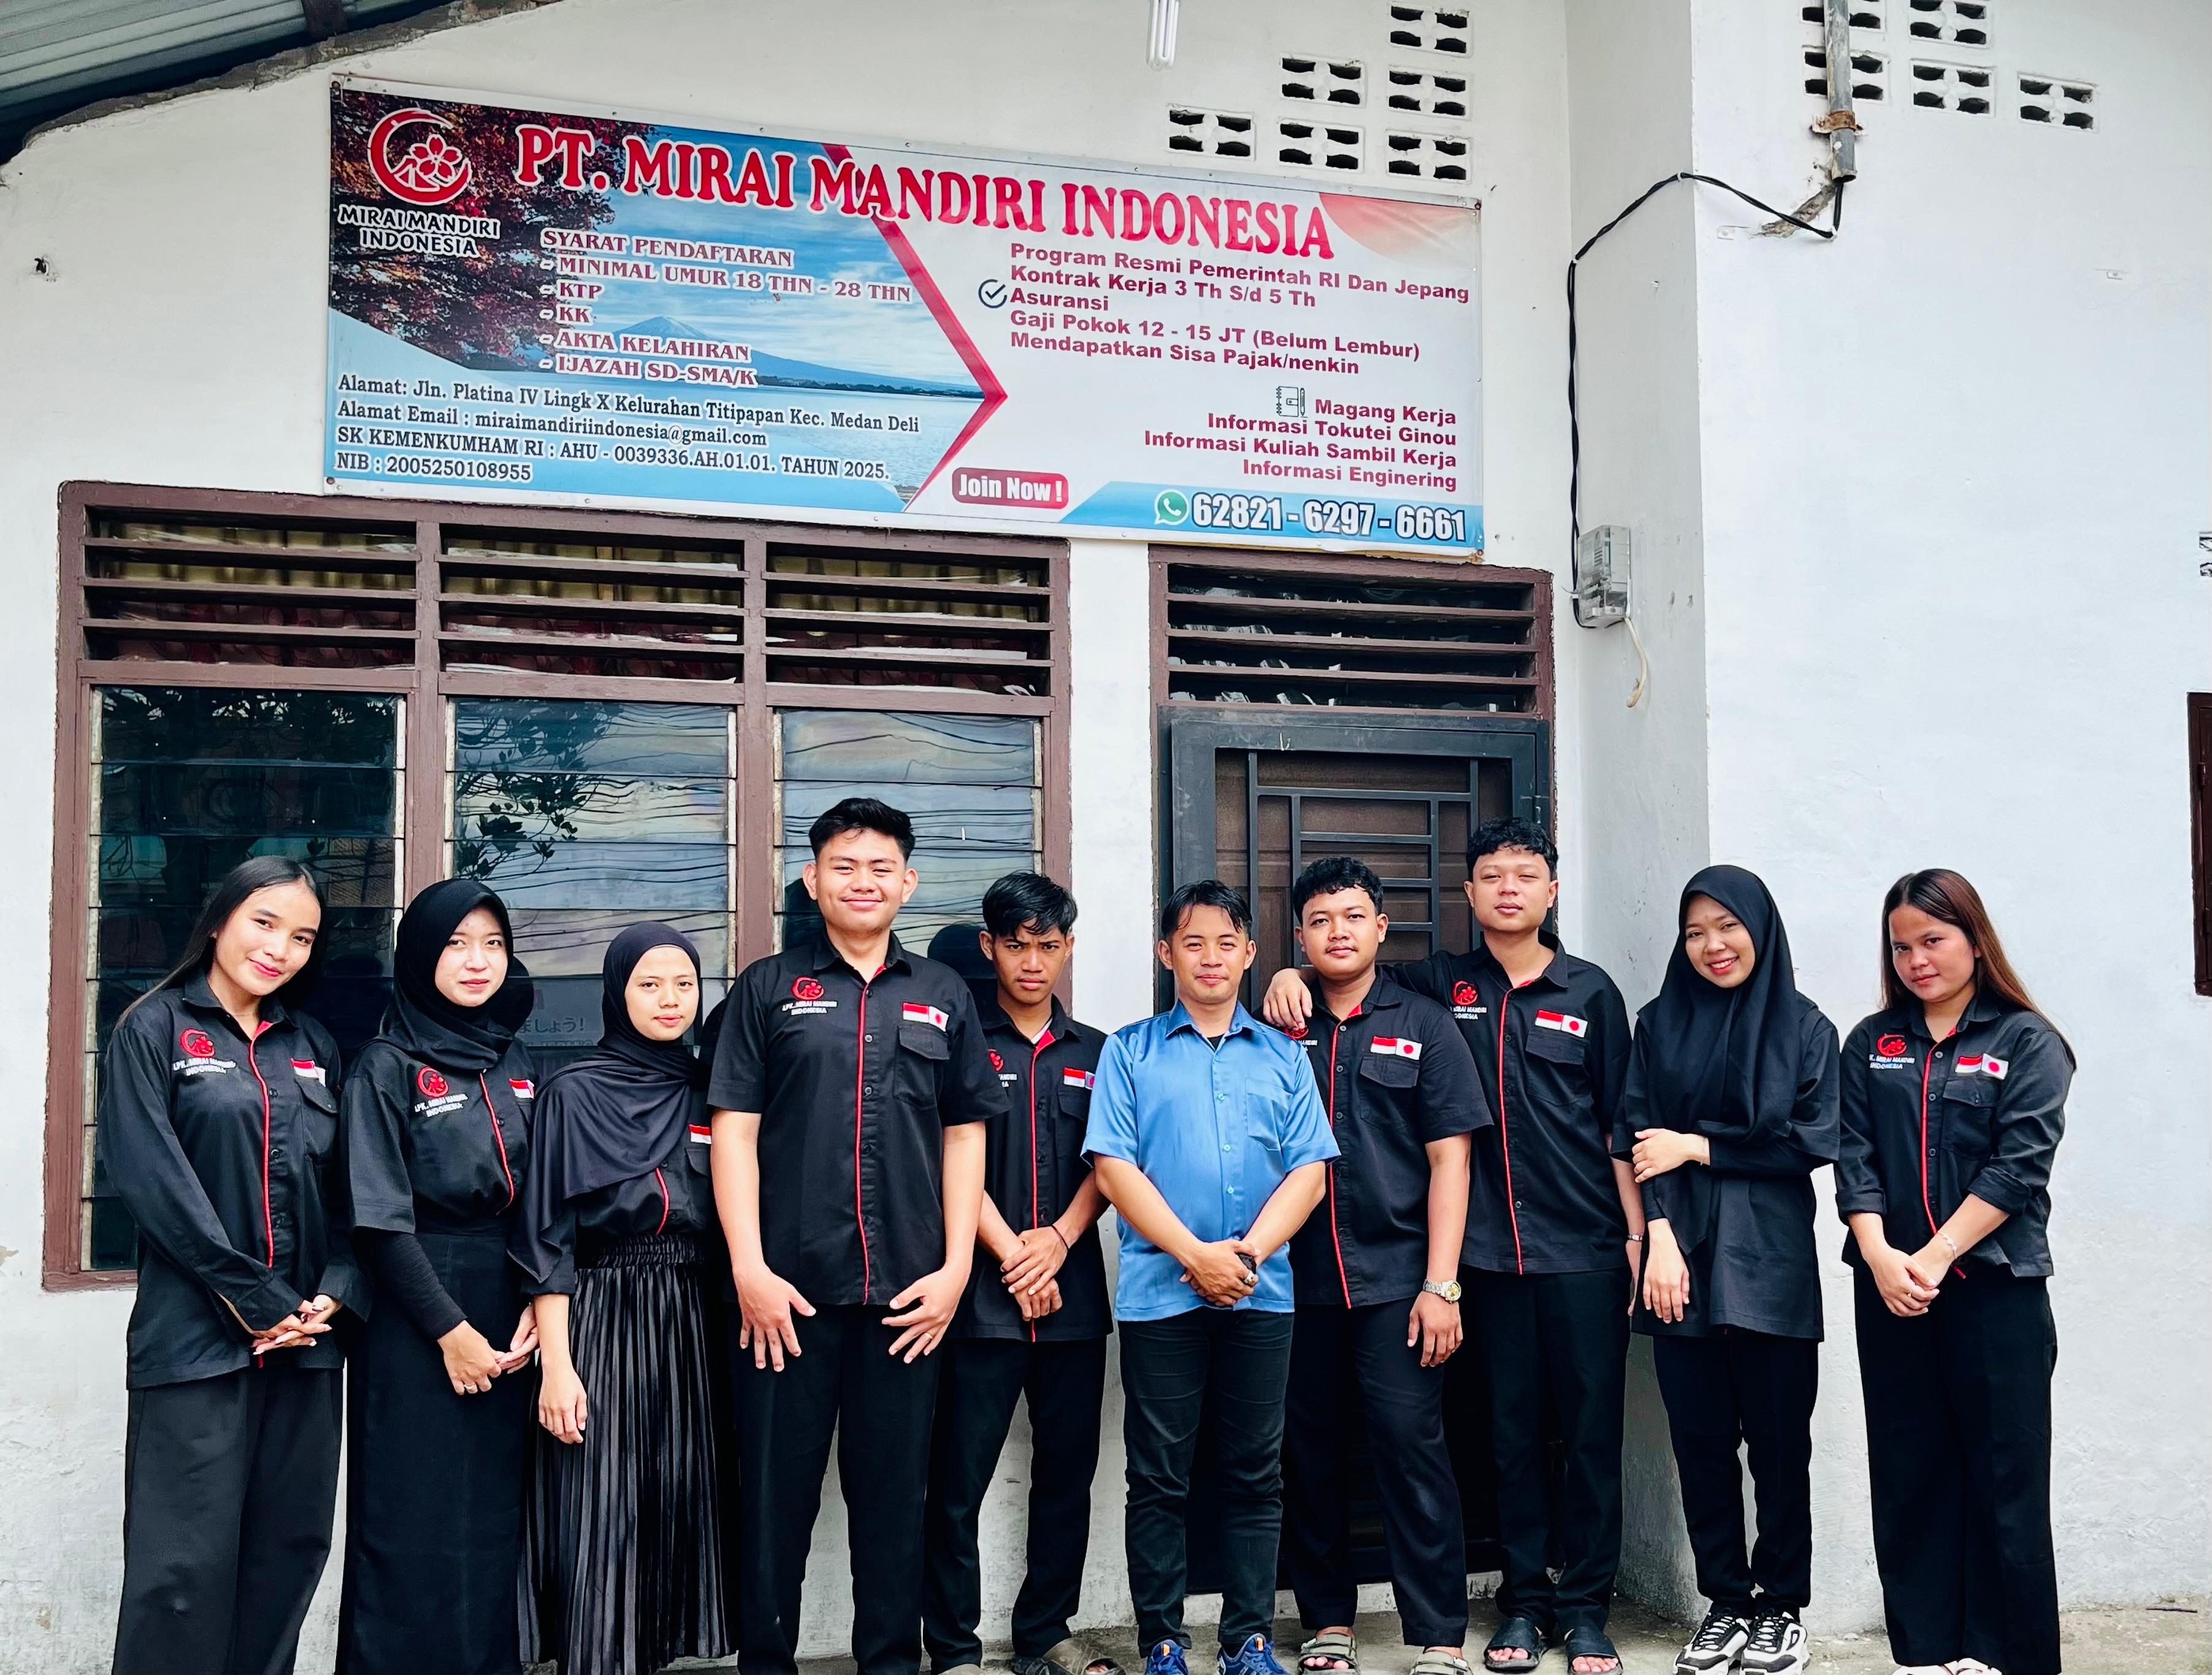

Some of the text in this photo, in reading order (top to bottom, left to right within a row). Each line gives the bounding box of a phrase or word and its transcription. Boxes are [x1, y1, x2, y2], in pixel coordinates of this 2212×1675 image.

[517, 126, 1336, 260] PT. MIRAI MANDIRI INDONESIA
[361, 229, 476, 256] INDONESIA
[543, 230, 792, 267] SYARAT PENDAFTARAN
[559, 257, 657, 280] MINIMAL
[664, 266, 727, 286] UMUR
[735, 273, 761, 289] 18
[768, 275, 813, 293] THN
[835, 282, 862, 297] 28
[868, 284, 911, 302] THN
[559, 282, 603, 299] KTP
[1011, 242, 1469, 304] Program Resmi Pemerintah RI Dan Jepang
[1011, 264, 1316, 307] Kontrak Kerja 3 Th S/d 5 Th
[559, 306, 589, 323] KK
[1010, 287, 1109, 311] Asuransi
[556, 332, 614, 350] AKTA
[622, 337, 749, 360] KELAHIRAN
[1011, 310, 1055, 332] Gaji
[1063, 313, 1130, 335] Pokok
[1139, 320, 1165, 337] 12
[1185, 324, 1211, 340] 15
[1218, 327, 1246, 343] JT
[1253, 329, 1327, 351] (Belum
[1334, 335, 1420, 362] Lembur)
[1011, 331, 1359, 375] Mendapatkan Sisa Pajak/nenkin
[557, 356, 640, 376] IJAZAH
[647, 362, 757, 386] SD-SMA/K
[337, 374, 920, 432] Alamat: Jln. Platina IV Lingk X Kelurahan Titipapan Kec. Medan Deli
[1315, 399, 1456, 427] Magang Kerja
[337, 400, 402, 420] Alamat
[407, 405, 459, 425] Email
[475, 411, 768, 446] miraimandiriindonesia@gmail.com
[1207, 412, 1456, 445] Informasi Tokutei Ginou
[337, 426, 364, 444] SK
[369, 428, 519, 454] KEMENKUMHAM
[524, 440, 544, 456] RI
[560, 442, 598, 459] AHU
[781, 456, 840, 476] TAHUN
[843, 461, 889, 479] 2025.
[337, 452, 369, 470] NIB
[386, 456, 532, 481] 2005250108955
[1144, 430, 1456, 470] Informasi Kuliah Sambil Kerja
[958, 473, 1002, 499] Join
[1243, 459, 1456, 493] Informasi Enginering
